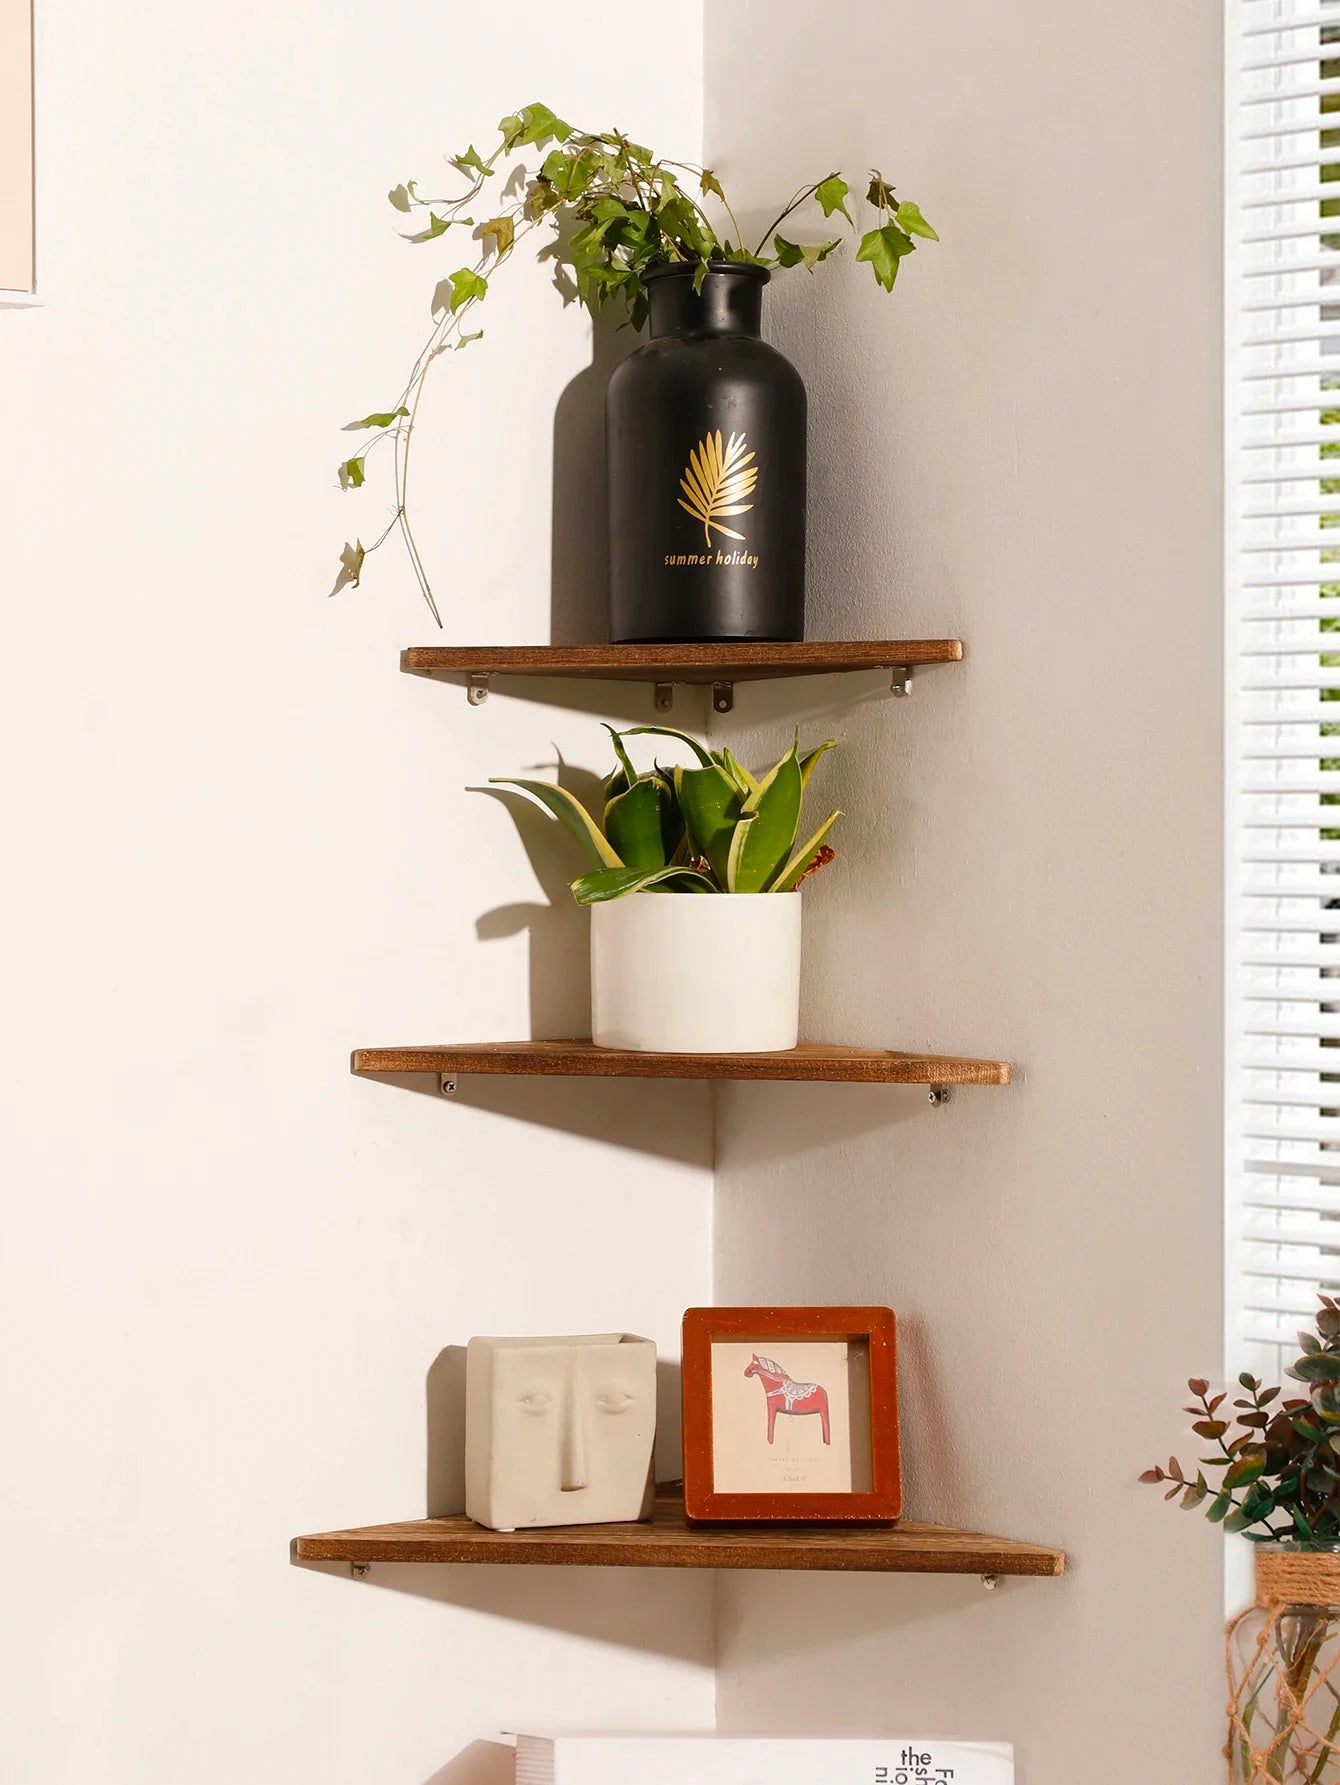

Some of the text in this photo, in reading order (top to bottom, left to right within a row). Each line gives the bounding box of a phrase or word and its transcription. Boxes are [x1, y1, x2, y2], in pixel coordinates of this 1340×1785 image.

[664, 549, 759, 569] summer holiday
[900, 1746, 932, 1766] the
